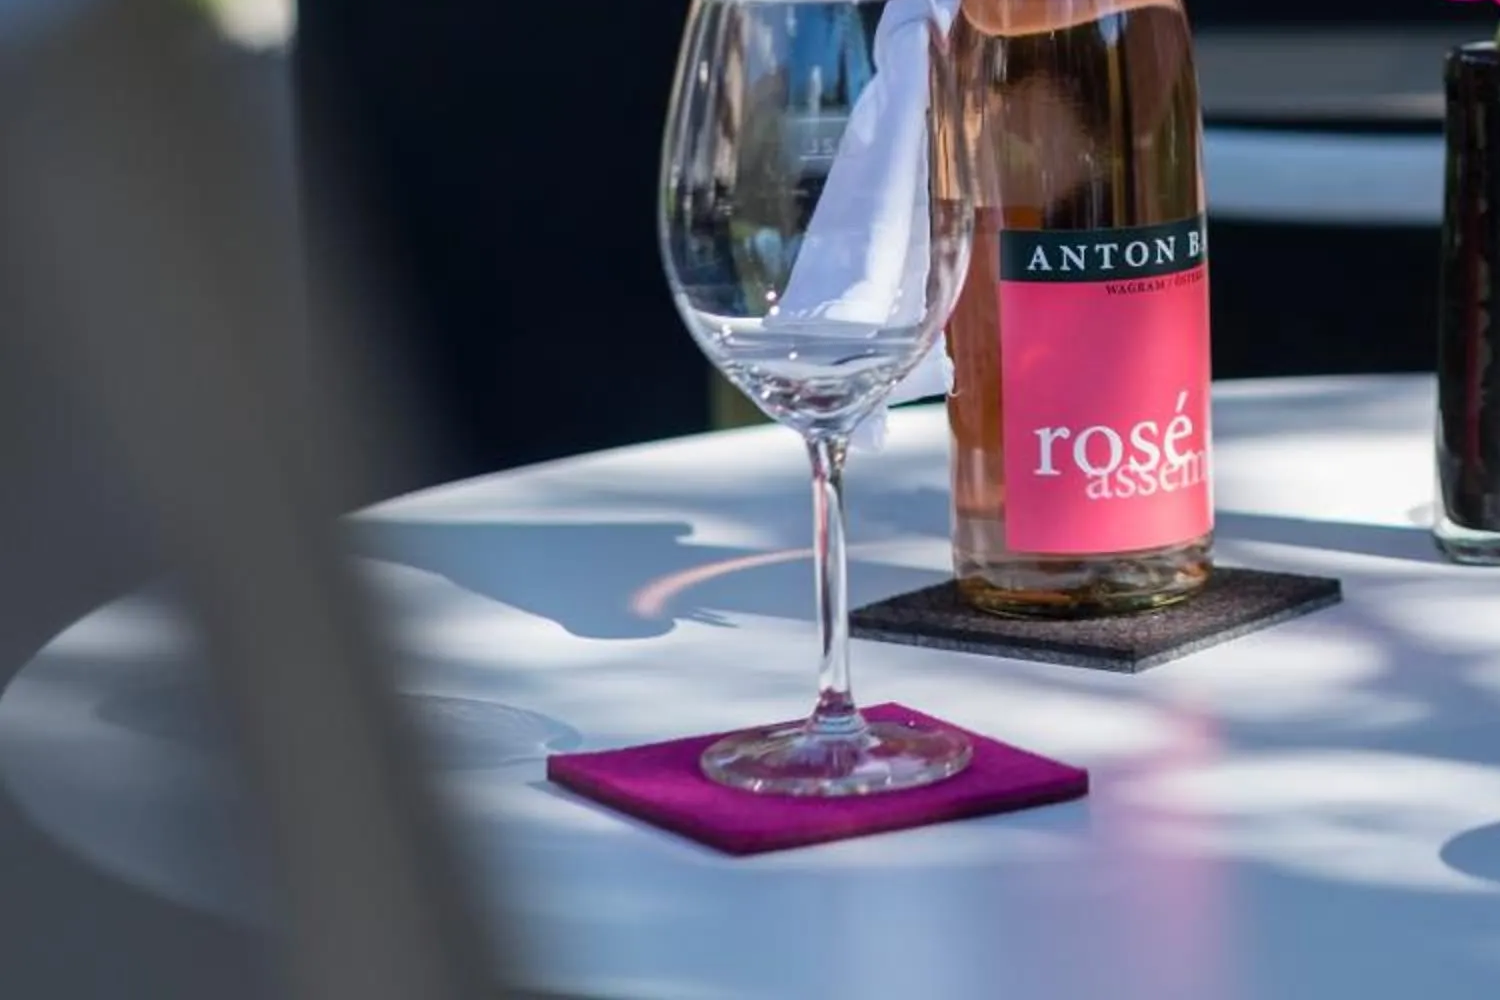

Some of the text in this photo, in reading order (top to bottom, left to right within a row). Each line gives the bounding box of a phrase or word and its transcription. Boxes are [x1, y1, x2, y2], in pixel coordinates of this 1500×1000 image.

[1027, 236, 1175, 270] ANTON
[1106, 279, 1165, 295] WAGRAM
[1033, 390, 1193, 477] rosé
